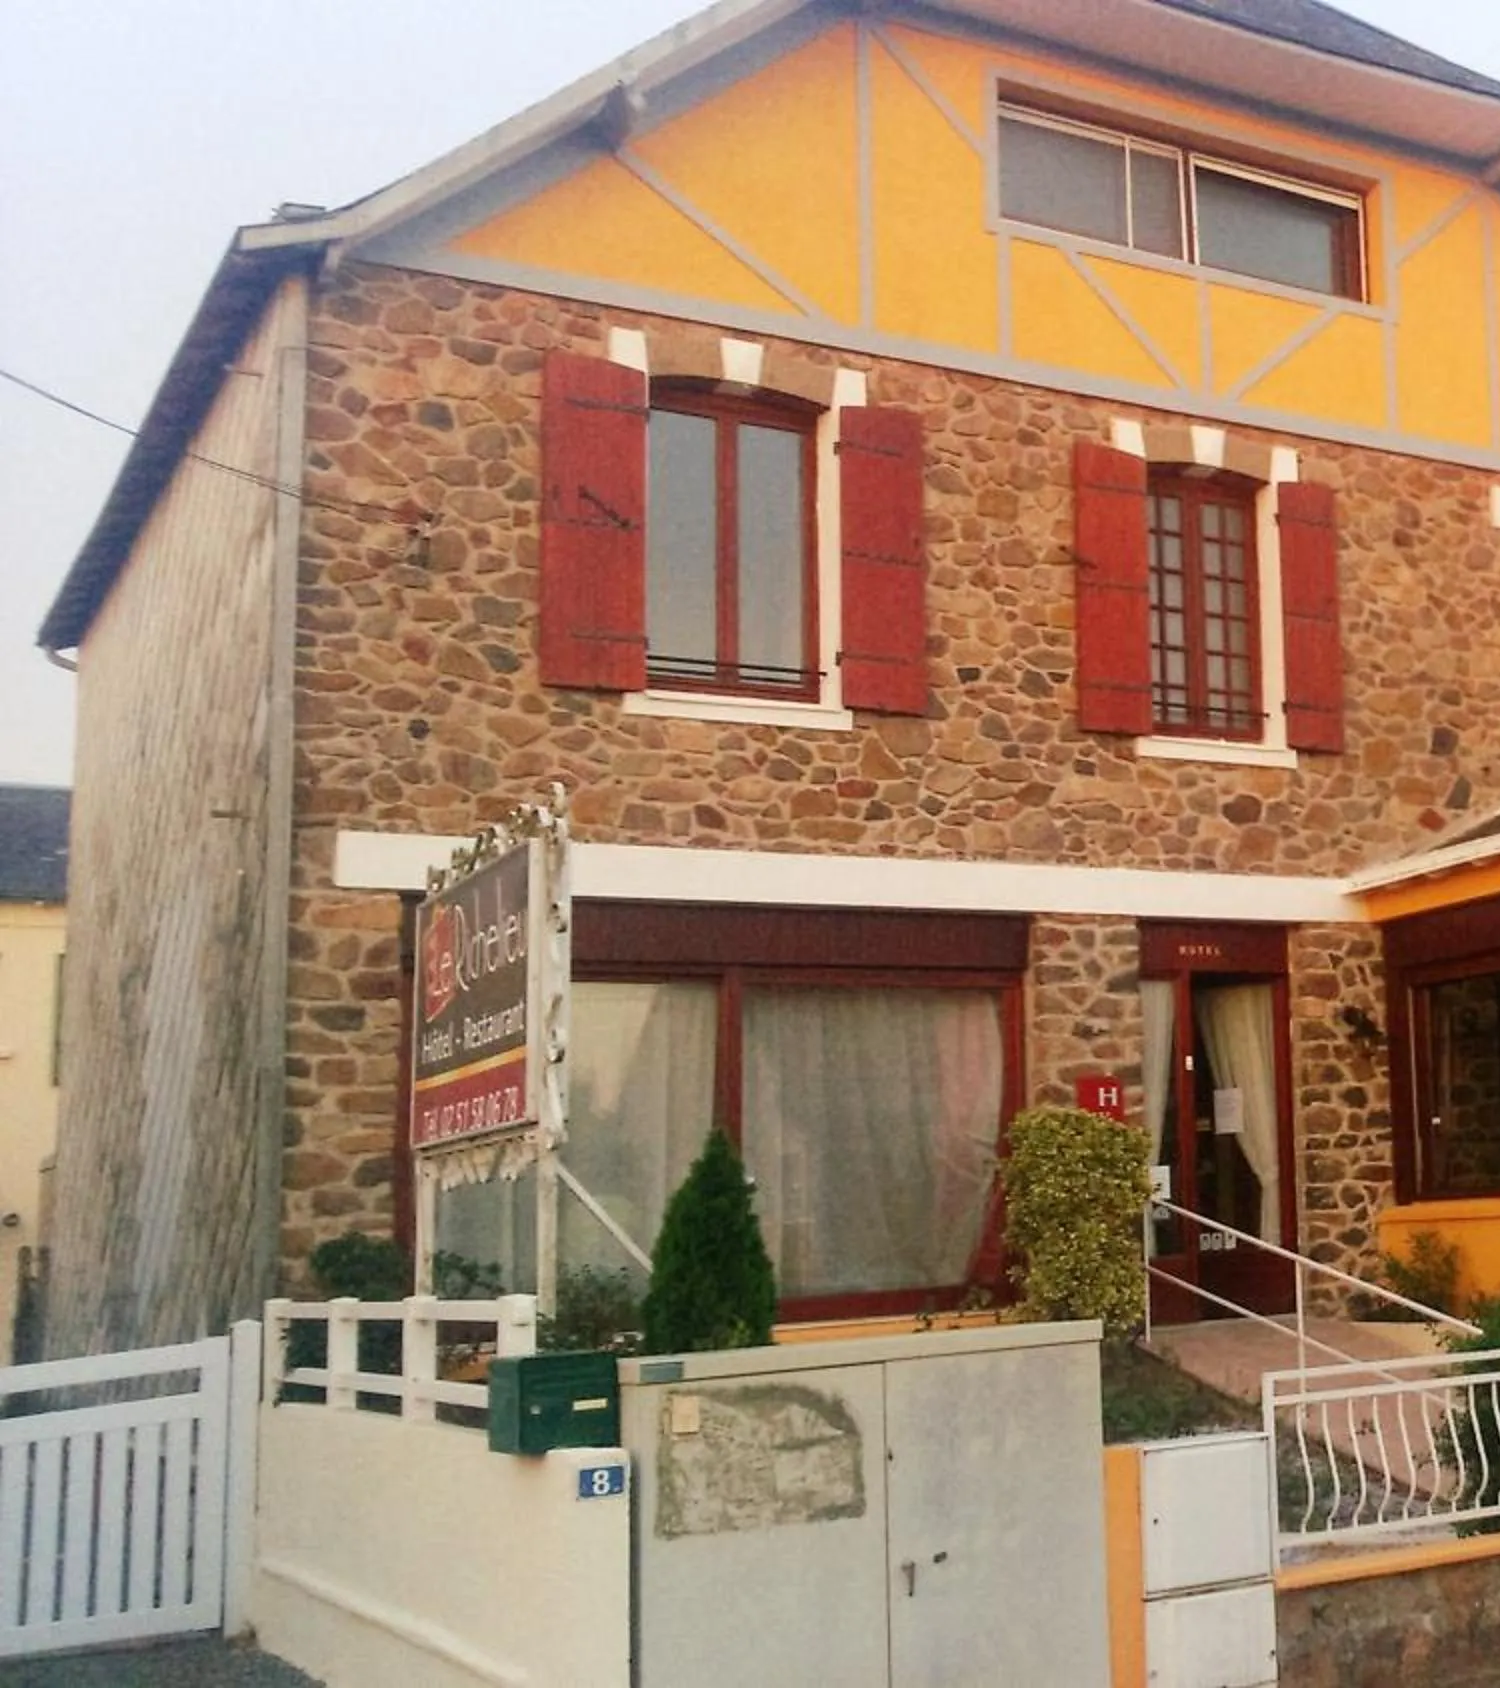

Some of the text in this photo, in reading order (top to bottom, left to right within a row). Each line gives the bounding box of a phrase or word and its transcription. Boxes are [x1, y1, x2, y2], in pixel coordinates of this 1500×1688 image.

[422, 1021, 454, 1064] Hôtel
[463, 1000, 525, 1051] Restaurant
[1099, 1087, 1117, 1106] H
[592, 1470, 609, 1494] 8
